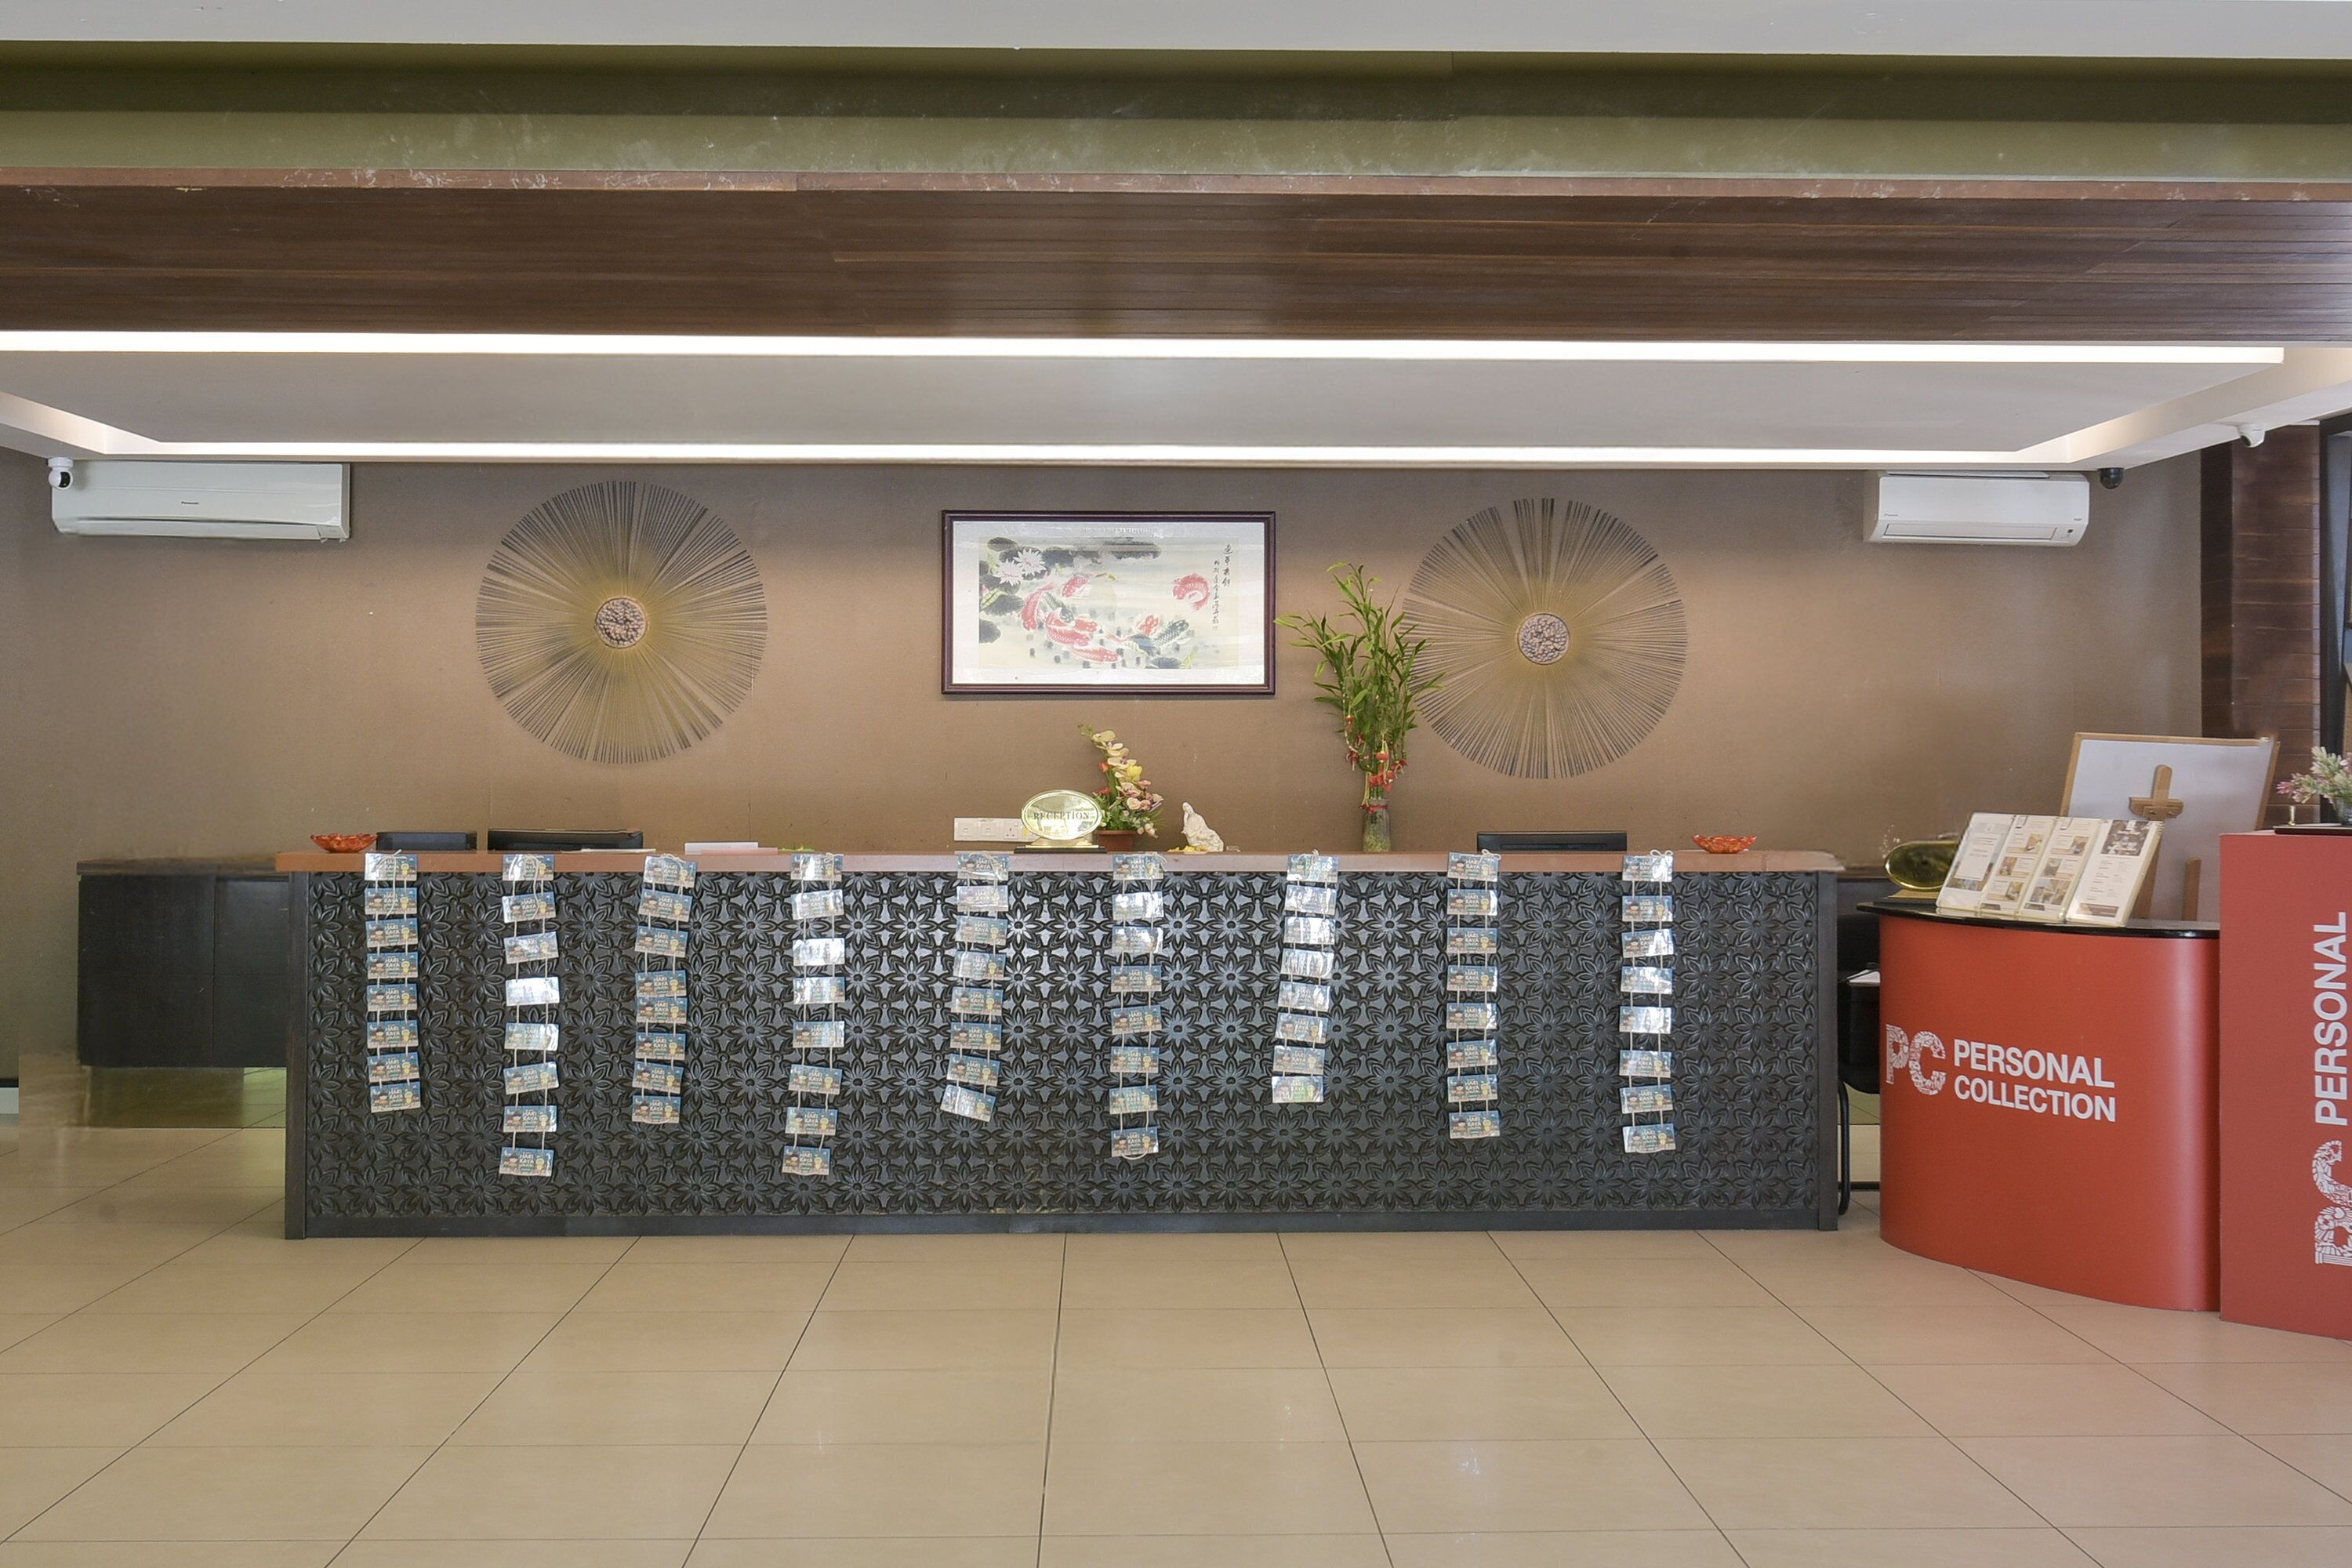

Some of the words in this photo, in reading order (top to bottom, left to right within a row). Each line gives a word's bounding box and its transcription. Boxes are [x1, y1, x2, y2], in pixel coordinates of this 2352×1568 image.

[1033, 811, 1091, 820] RECEPTION
[2313, 911, 2347, 1126] PERSONAL
[1886, 1024, 1947, 1095] PC
[1954, 1039, 2115, 1088] PERSONAL
[1954, 1075, 2116, 1122] COLLECTION
